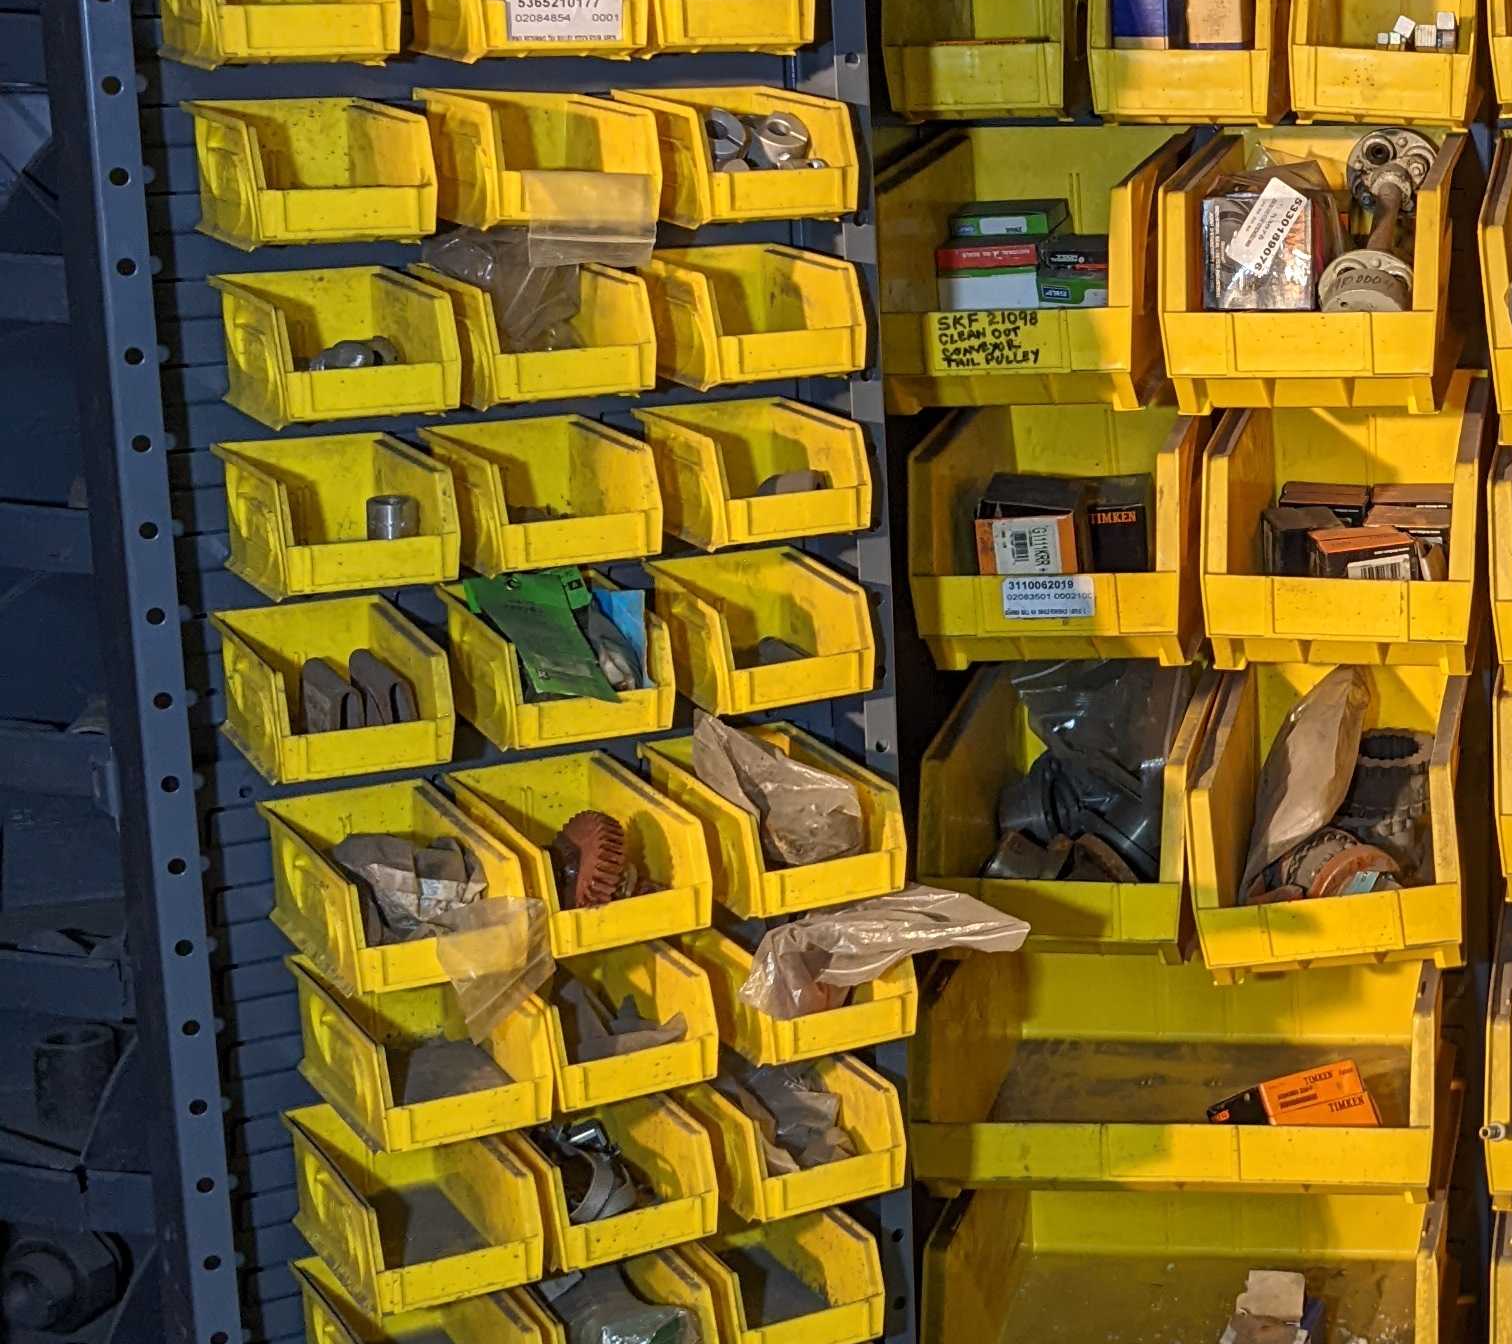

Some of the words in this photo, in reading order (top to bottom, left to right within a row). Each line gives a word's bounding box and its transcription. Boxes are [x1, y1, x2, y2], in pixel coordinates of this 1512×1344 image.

[591, 13, 619, 23] 0001
[1254, 197, 1304, 273] 5330189076
[937, 312, 979, 331] SKF
[986, 311, 1038, 326] 21098
[938, 327, 987, 345] CLEAN
[991, 326, 1020, 339] OUT
[942, 338, 1022, 357] CONVEYOR
[942, 357, 980, 368] TAIL
[984, 348, 1040, 365] PULLEY
[1091, 511, 1137, 524] TIMKEN
[1008, 580, 1074, 590] 3110062019
[1303, 1071, 1334, 1086] TIMKEN
[1327, 1096, 1366, 1113] TIMKEN
